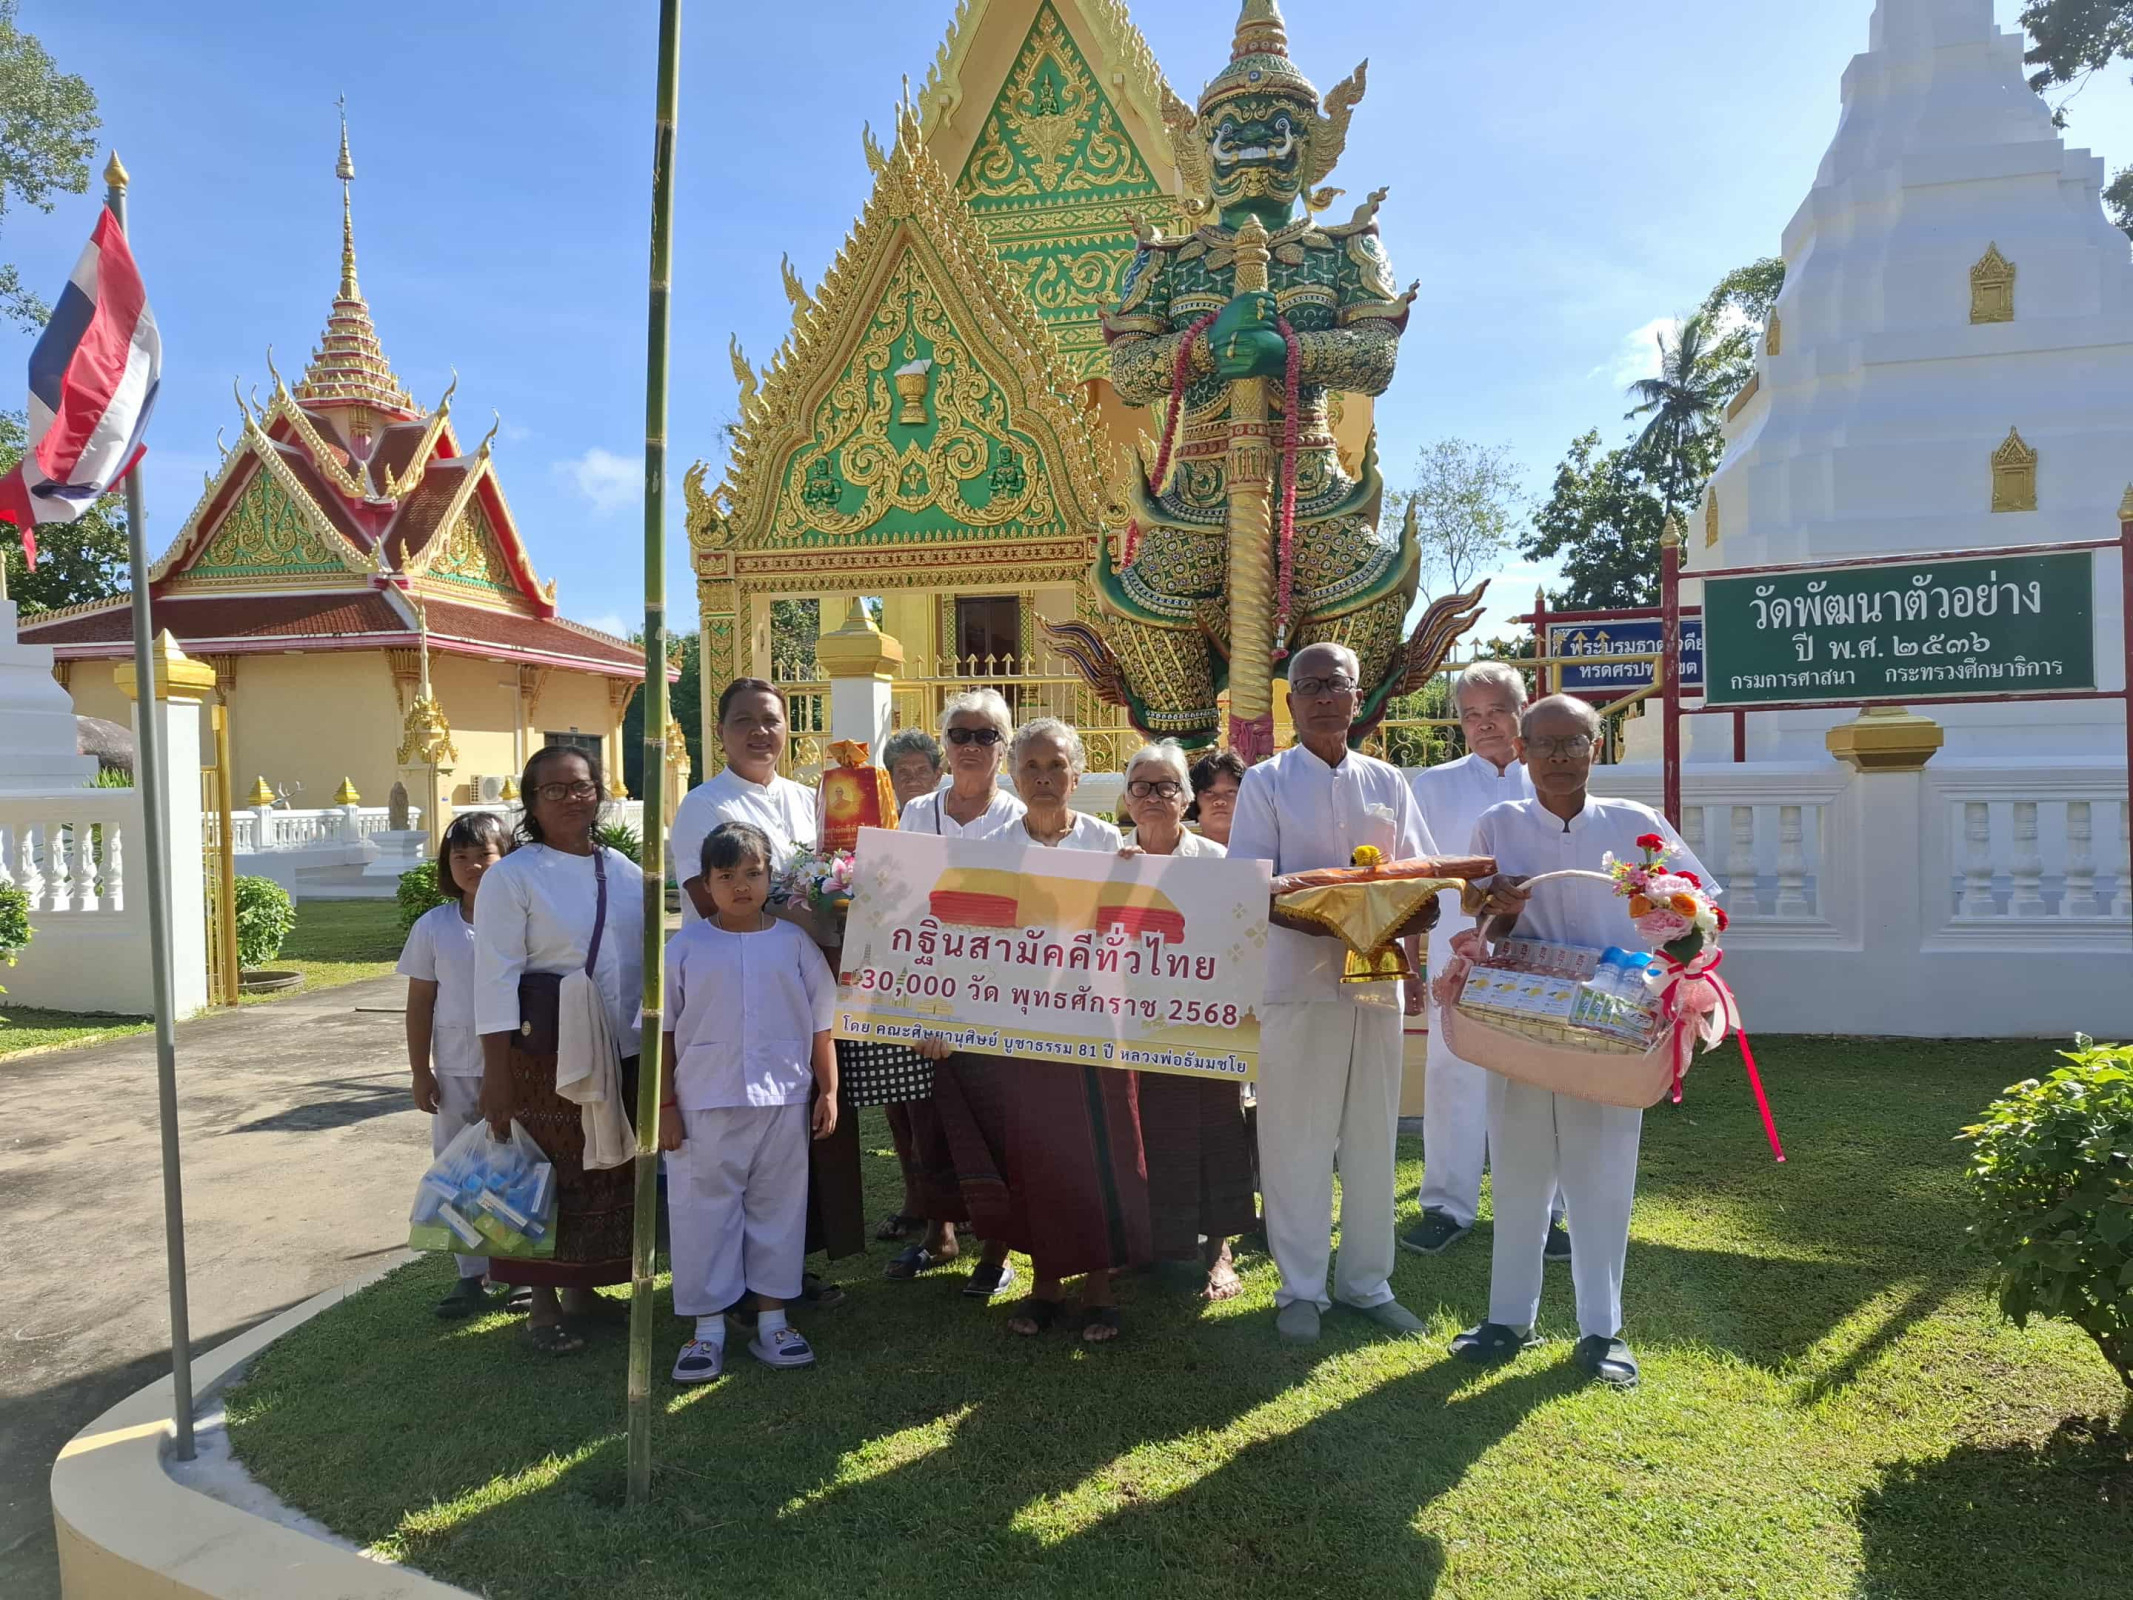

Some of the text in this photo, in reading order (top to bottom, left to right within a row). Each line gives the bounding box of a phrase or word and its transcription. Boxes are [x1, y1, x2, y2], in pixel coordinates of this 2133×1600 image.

[1749, 570, 2041, 630] วัดพัฒนาตัวอย่าง
[1731, 657, 2063, 690] กรมการศาสนา กระทรวงศึกษาธิการ
[1792, 631, 1814, 662] ปี
[1892, 631, 1991, 657] ๒๕๓๖
[891, 918, 1216, 981] กฐินสามัคคีทั่วไทย
[861, 968, 1238, 1026] 30,000 วัด พุทธศักราช 2568
[843, 1015, 871, 1033] โดย
[1004, 1036, 1073, 1056] บูชาธรรม
[1078, 1044, 1097, 1058] 81
[1103, 1042, 1115, 1060] ปี
[1120, 1048, 1247, 1074] หลวงพ่อธัมมชโย
